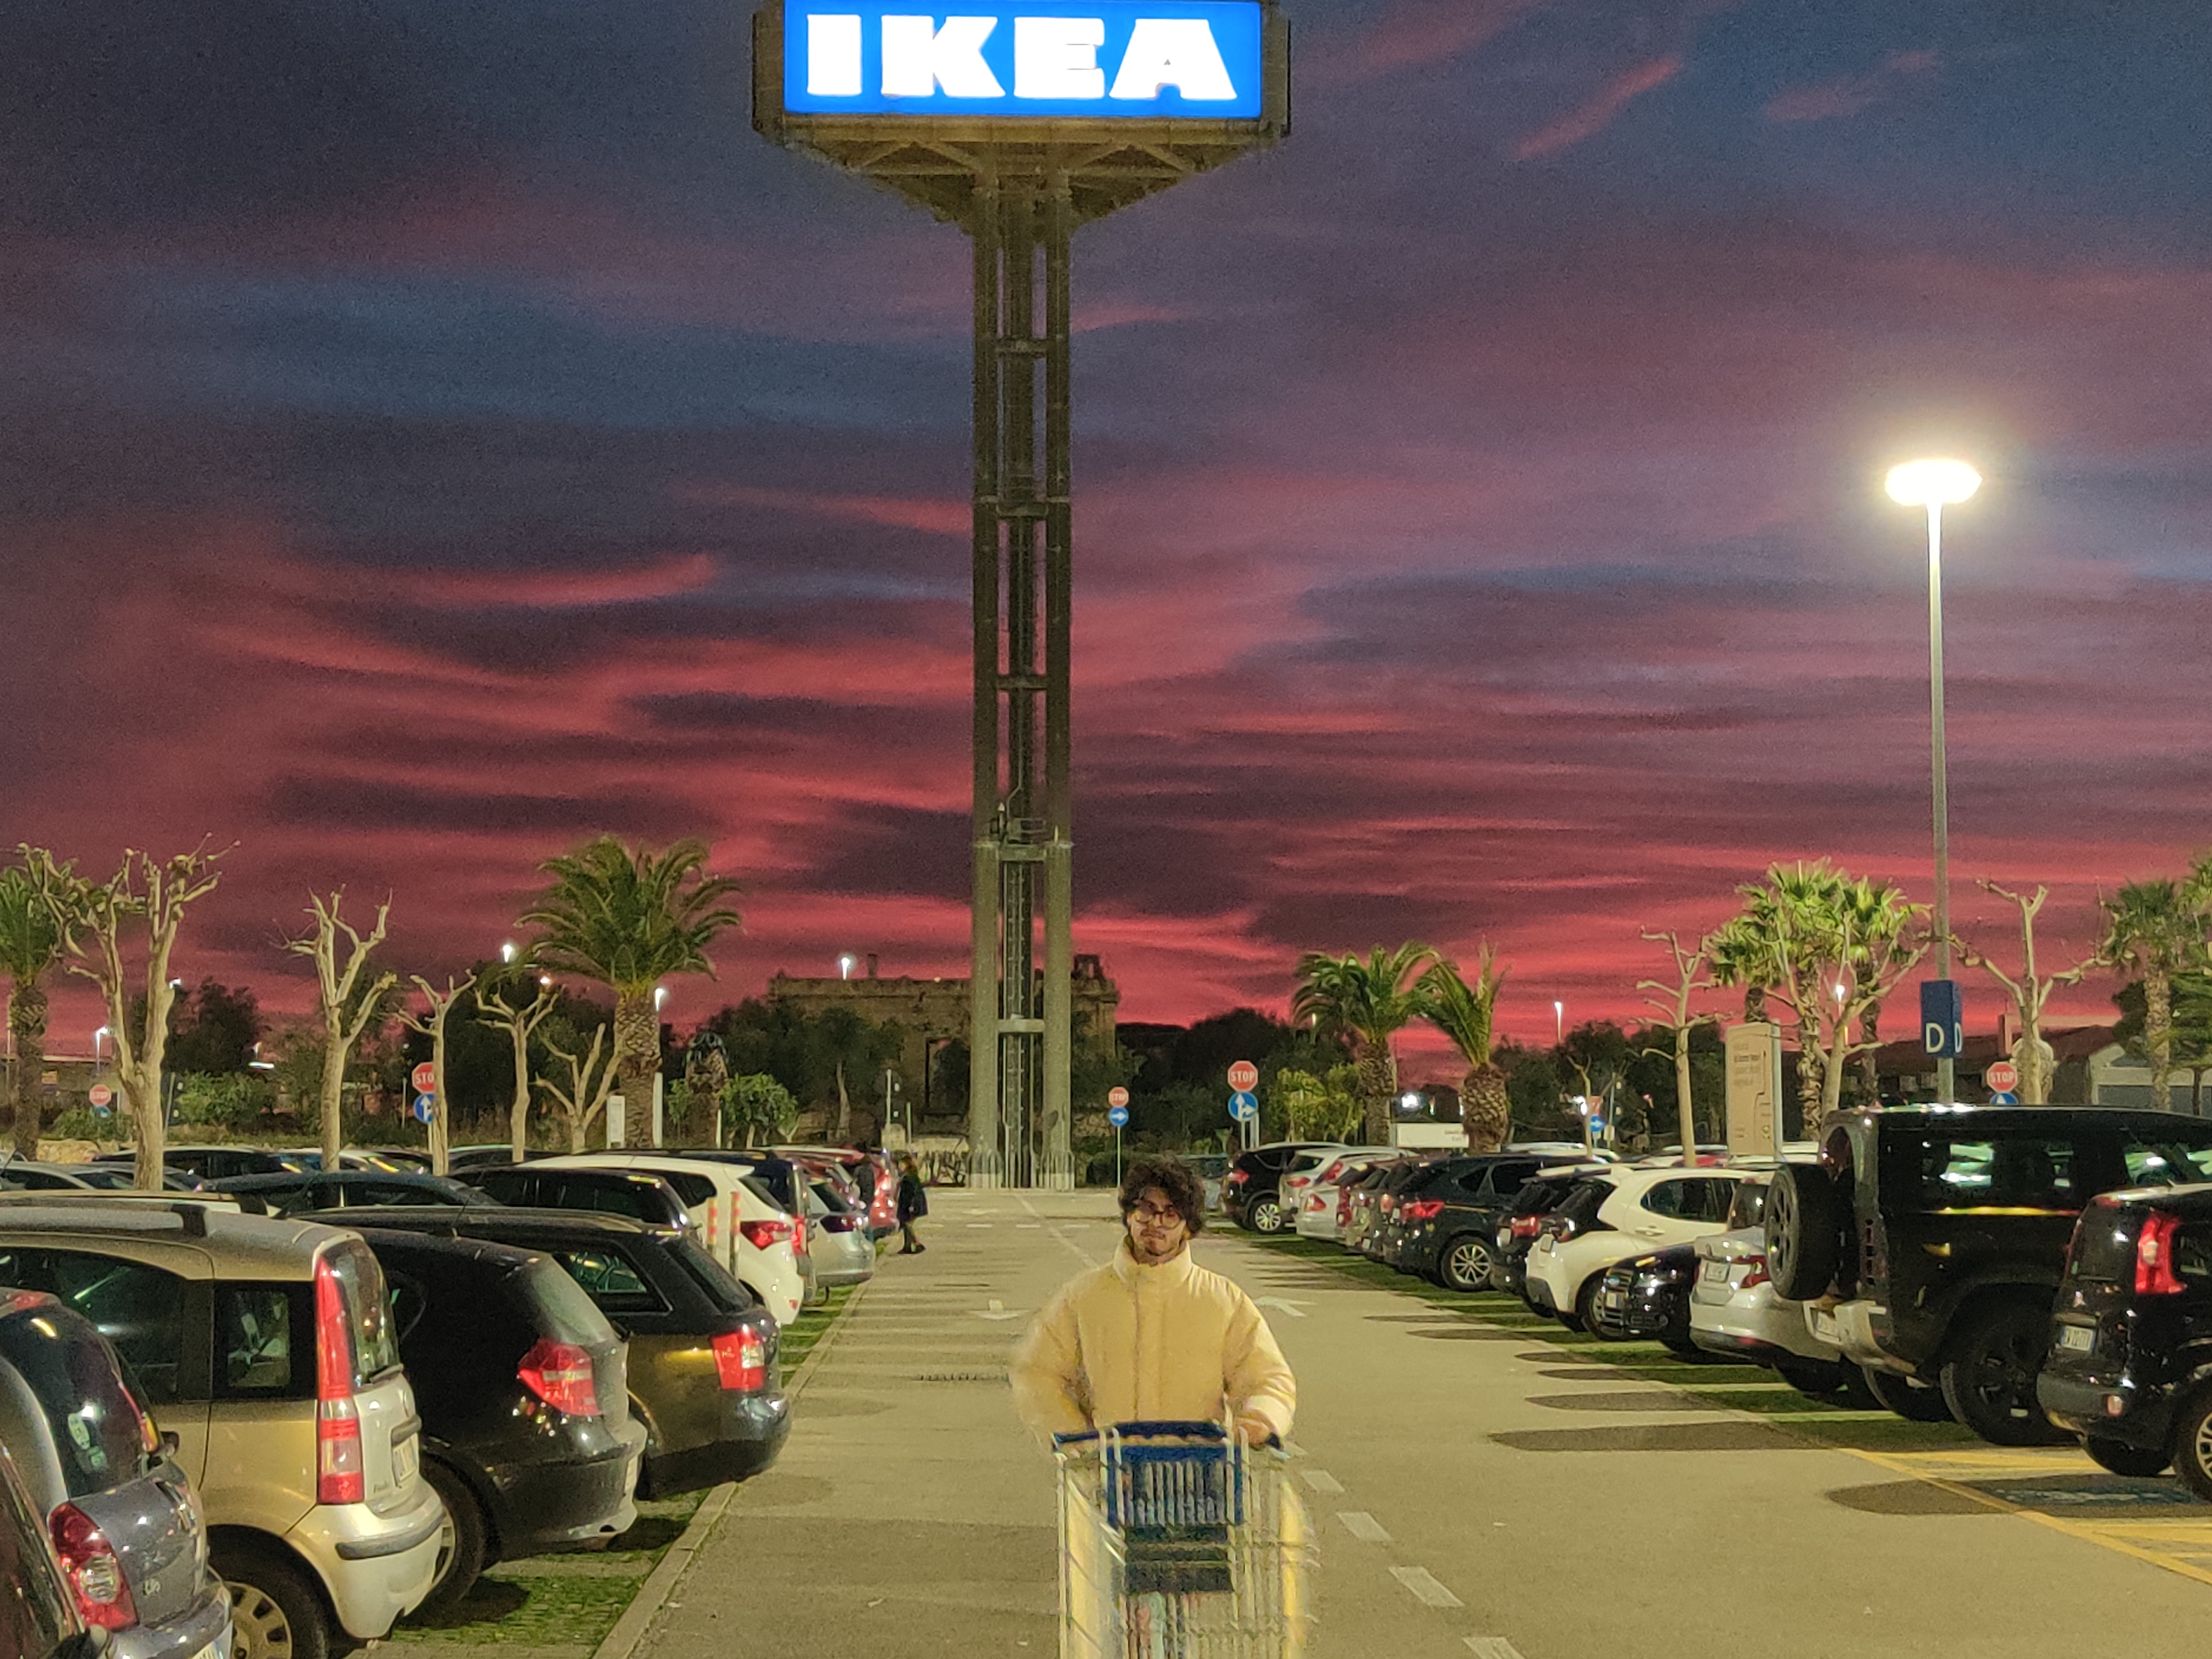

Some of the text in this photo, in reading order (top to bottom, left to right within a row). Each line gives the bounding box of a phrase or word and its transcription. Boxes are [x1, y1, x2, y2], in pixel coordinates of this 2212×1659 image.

[807, 14, 1237, 100] IKEA
[1926, 1022, 1944, 1053] D
[415, 1072, 435, 1084] STO
[1230, 1070, 1255, 1082] STOP
[1990, 1071, 2014, 1083] STOP
